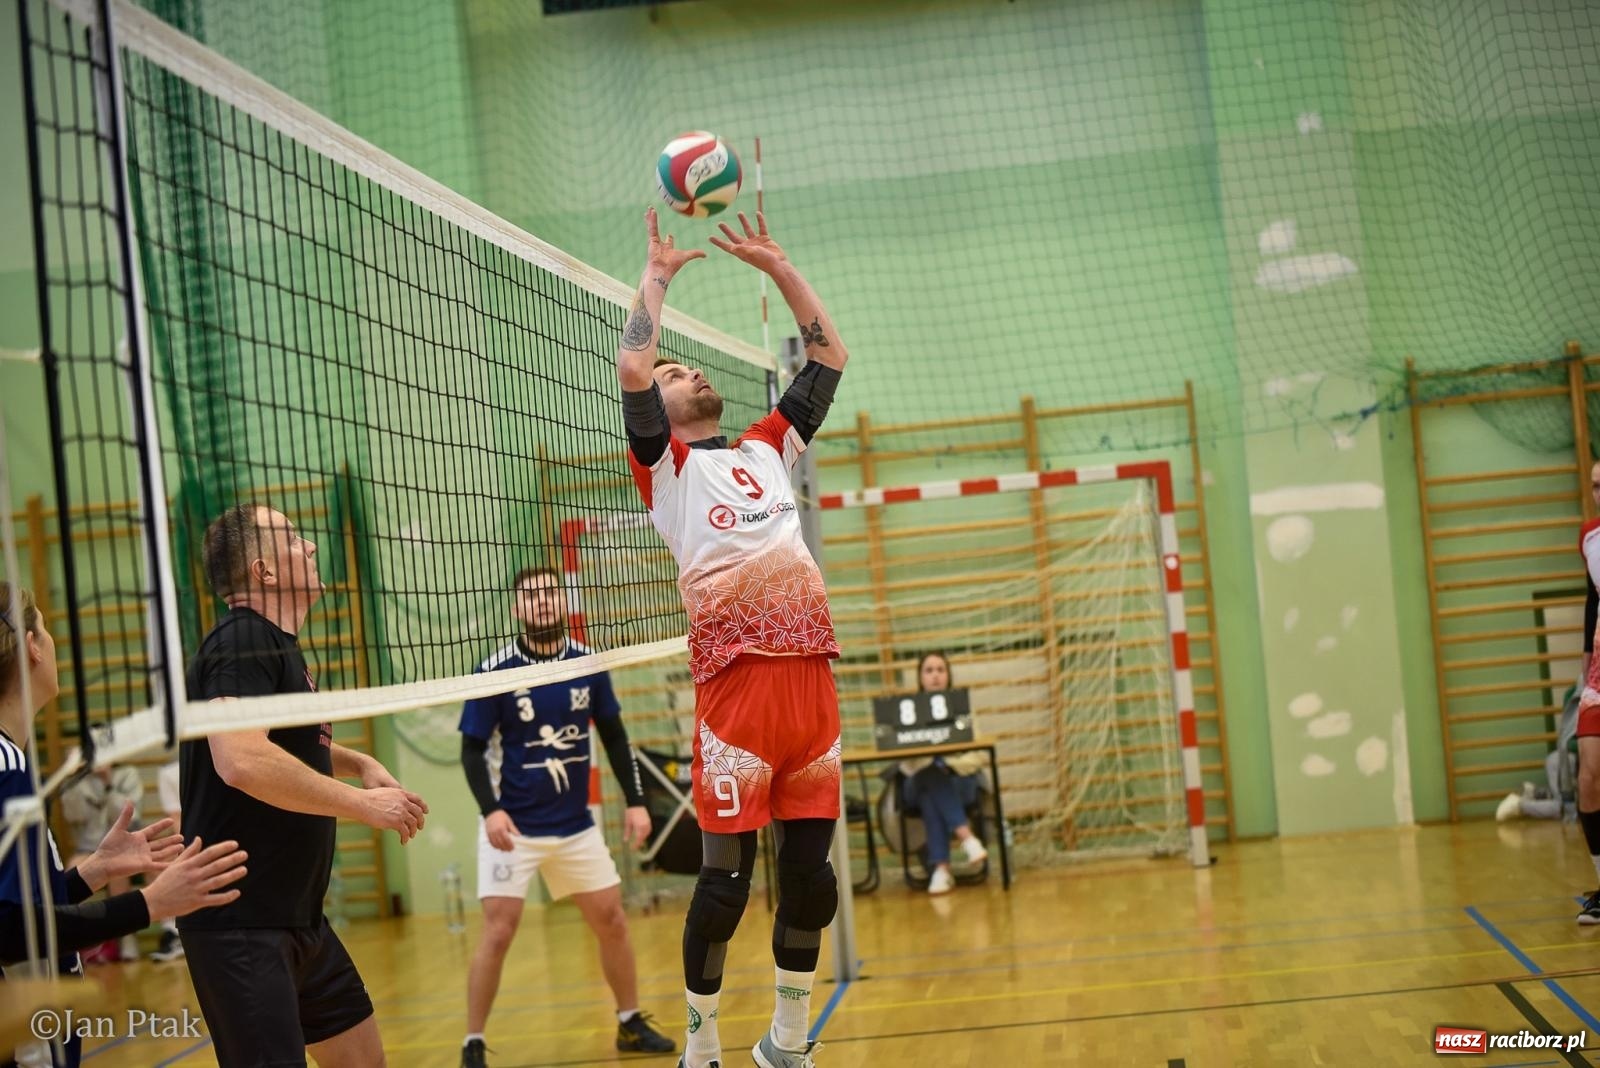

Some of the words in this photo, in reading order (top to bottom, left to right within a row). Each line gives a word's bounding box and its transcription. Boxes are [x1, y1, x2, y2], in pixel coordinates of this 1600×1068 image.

[732, 467, 764, 500] 9
[516, 697, 535, 722] 3
[900, 698, 917, 726] 8
[930, 694, 948, 721] 8
[714, 774, 741, 817] 9
